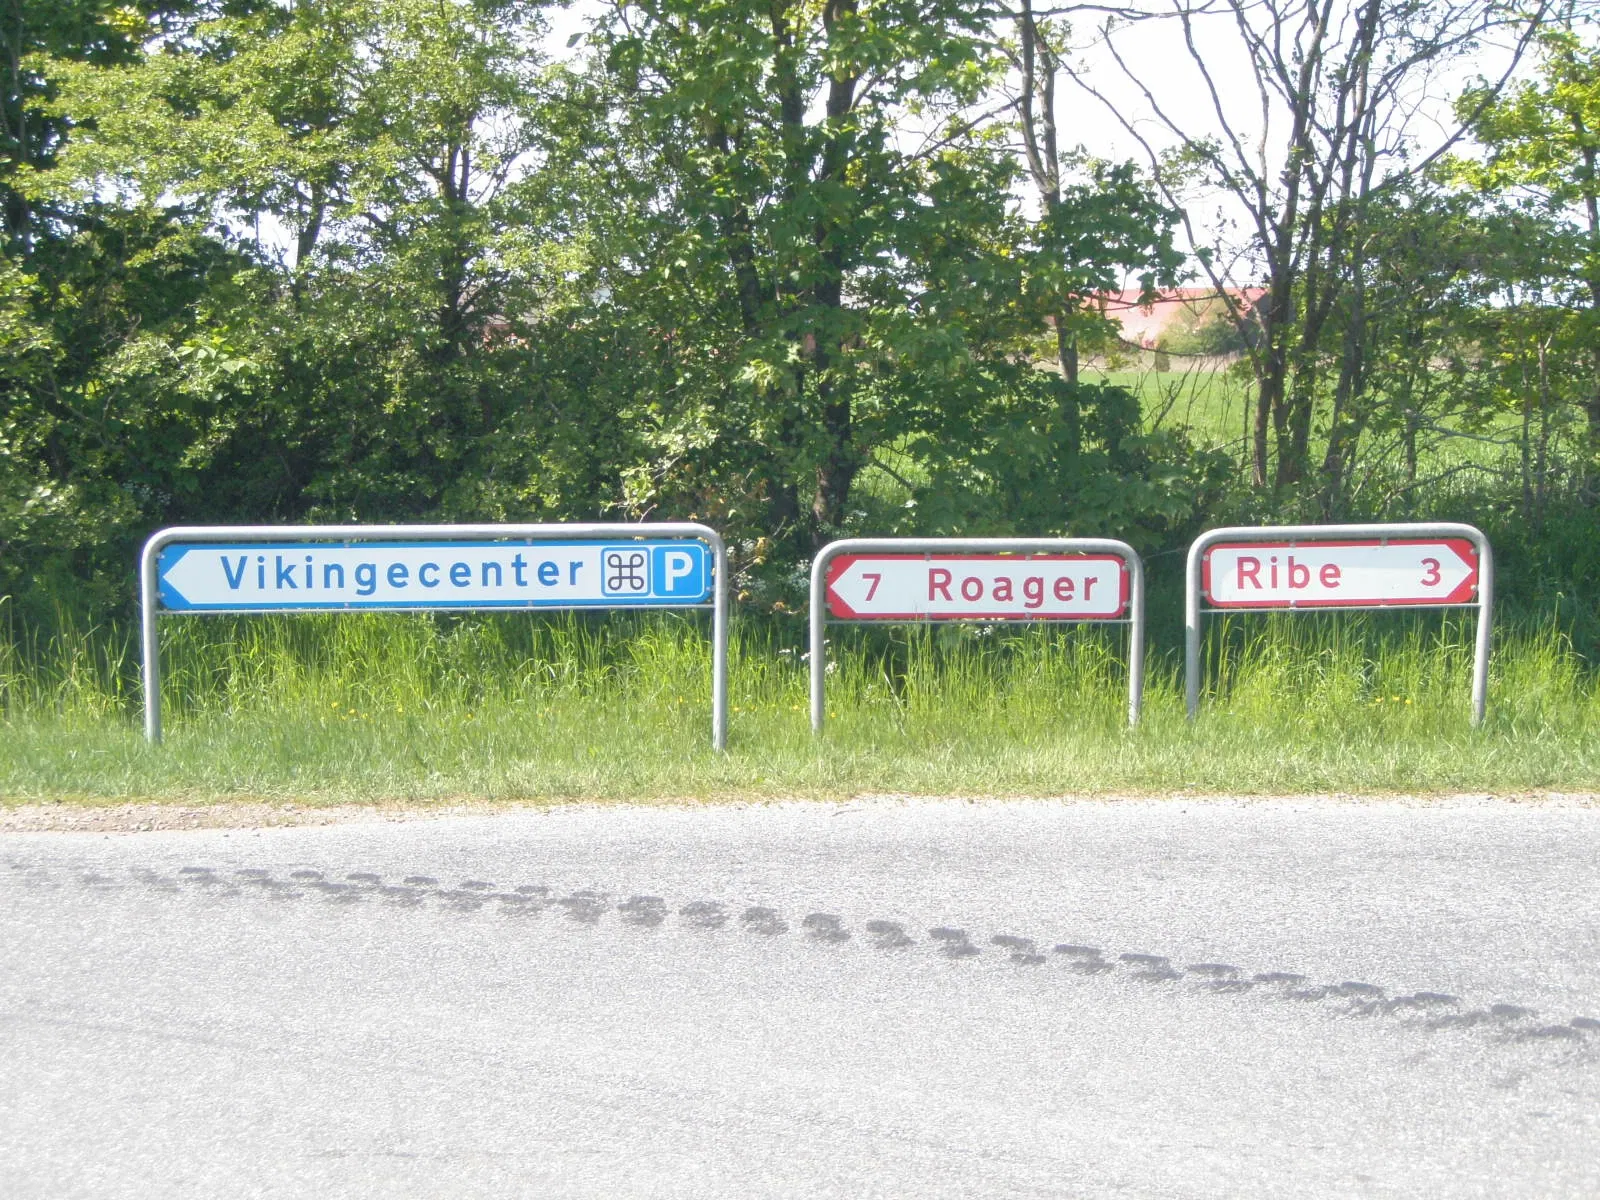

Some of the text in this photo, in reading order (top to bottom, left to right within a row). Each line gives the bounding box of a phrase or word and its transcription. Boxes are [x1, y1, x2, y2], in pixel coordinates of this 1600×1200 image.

[220, 551, 693, 596] Vikingecenter P
[861, 568, 1099, 608] 7 Roager
[1236, 555, 1442, 590] Ribe 3
